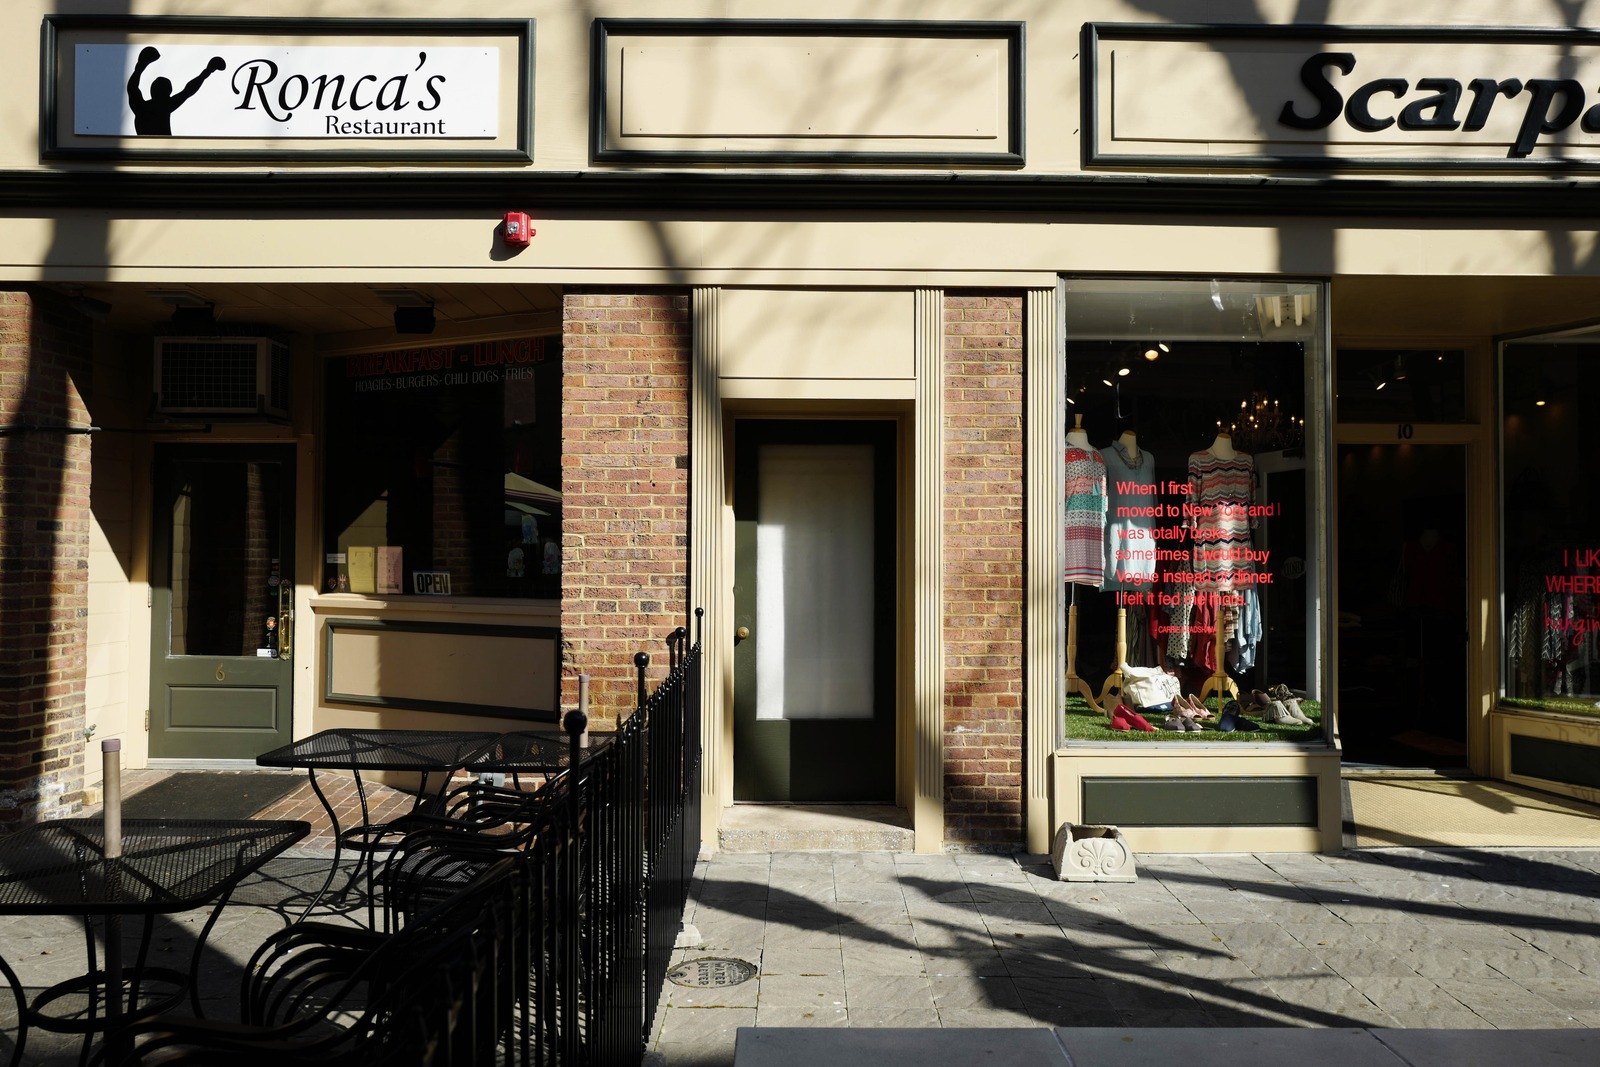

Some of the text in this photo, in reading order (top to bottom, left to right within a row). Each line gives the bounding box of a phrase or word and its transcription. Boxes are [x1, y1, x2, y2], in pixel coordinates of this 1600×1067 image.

[232, 52, 446, 122] Ronca's
[325, 115, 446, 135] Restaurant
[346, 346, 456, 377] BREAKFAST
[473, 338, 546, 367] LUNCH
[1398, 424, 1413, 440] 10
[1116, 481, 1193, 495] When I first
[1117, 502, 1281, 517] moved to New York and I
[1117, 528, 1144, 540] was
[1148, 525, 1187, 542] totally
[1115, 547, 1270, 565] sometimes I would buy
[1564, 549, 1568, 567] I
[416, 573, 449, 594] OPEN
[1116, 569, 1159, 585] Vogue
[1163, 569, 1210, 583] instead
[1215, 569, 1228, 583] of
[1231, 569, 1274, 584] dinner.
[1116, 592, 1120, 605] I
[1122, 591, 1143, 605] felt
[1147, 591, 1155, 605] it
[1158, 591, 1181, 605] fed
[1183, 594, 1206, 606] me
[215, 662, 225, 681] 6
[714, 962, 726, 985] WATER
